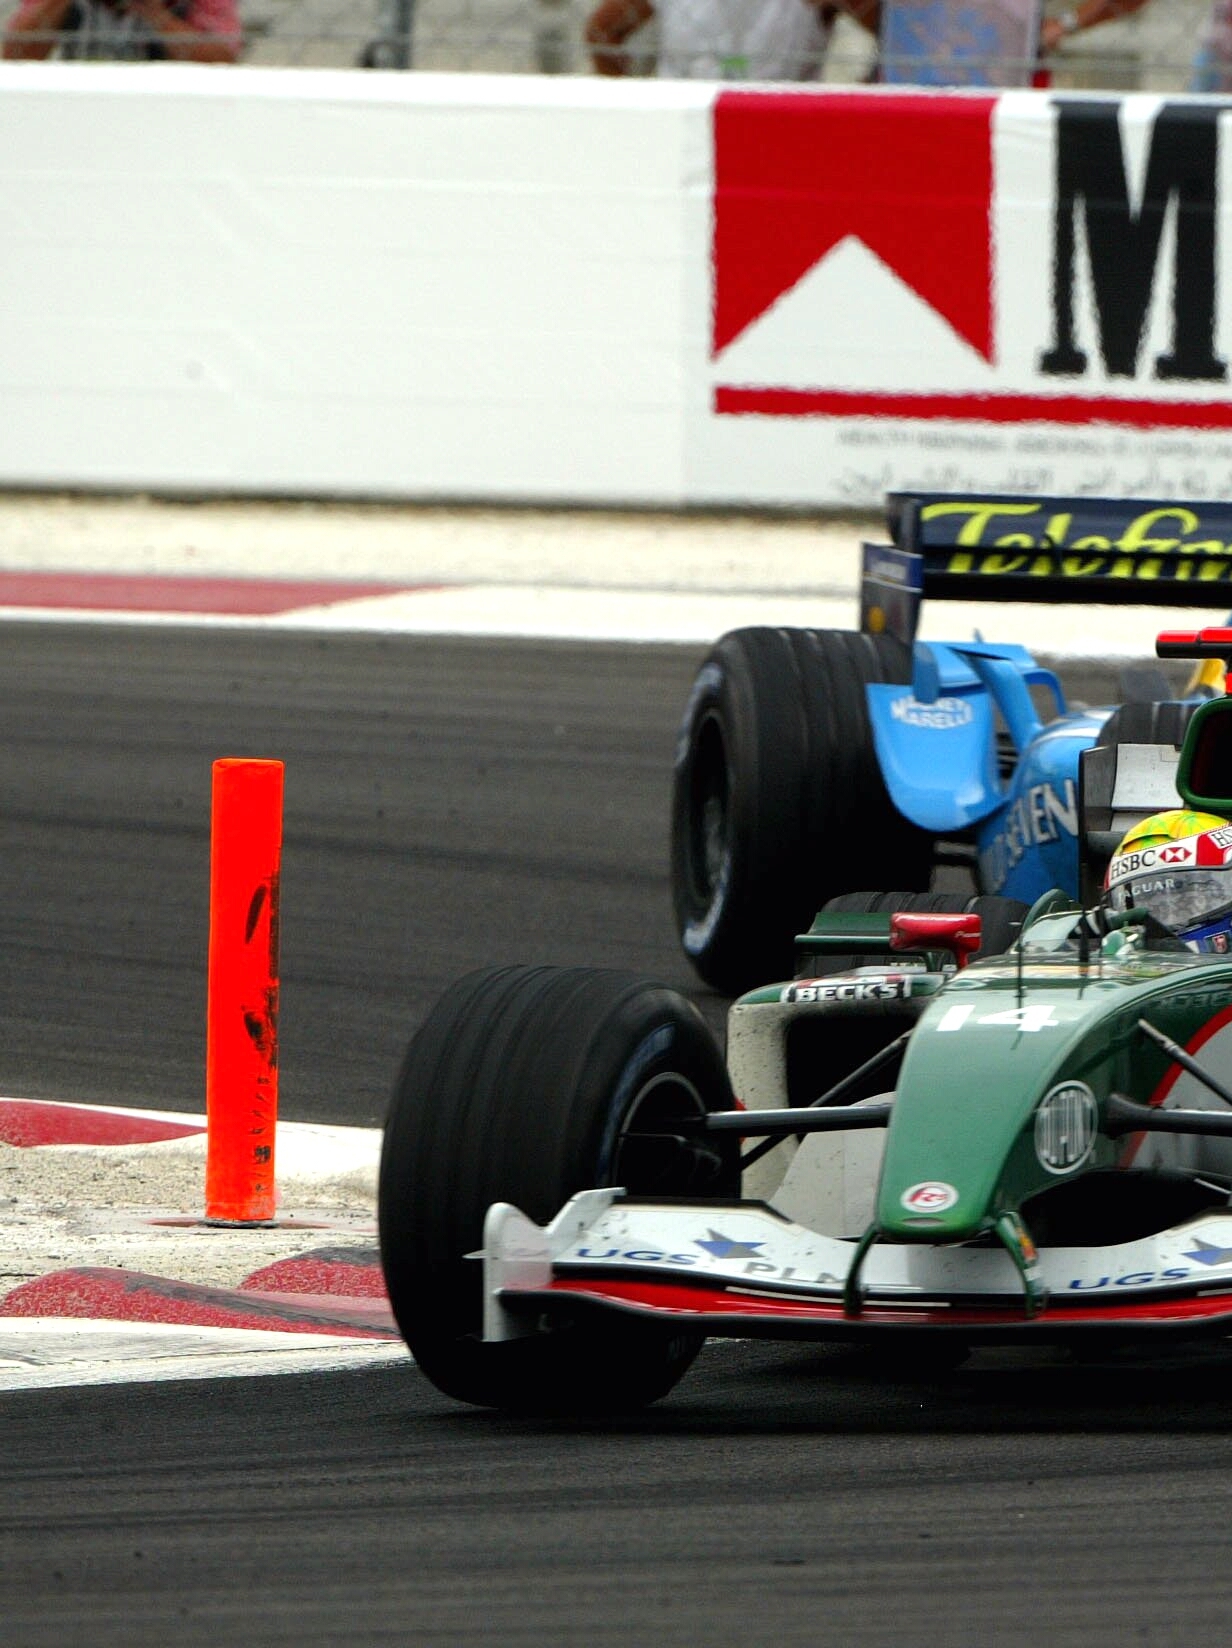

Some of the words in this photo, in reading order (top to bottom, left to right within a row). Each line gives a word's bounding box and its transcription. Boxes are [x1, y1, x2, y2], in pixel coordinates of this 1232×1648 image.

[1110, 850, 1154, 880] HSBC
[936, 1004, 1059, 1032] 14
[577, 1247, 700, 1266] UGS
[1069, 1267, 1191, 1291] UGS
